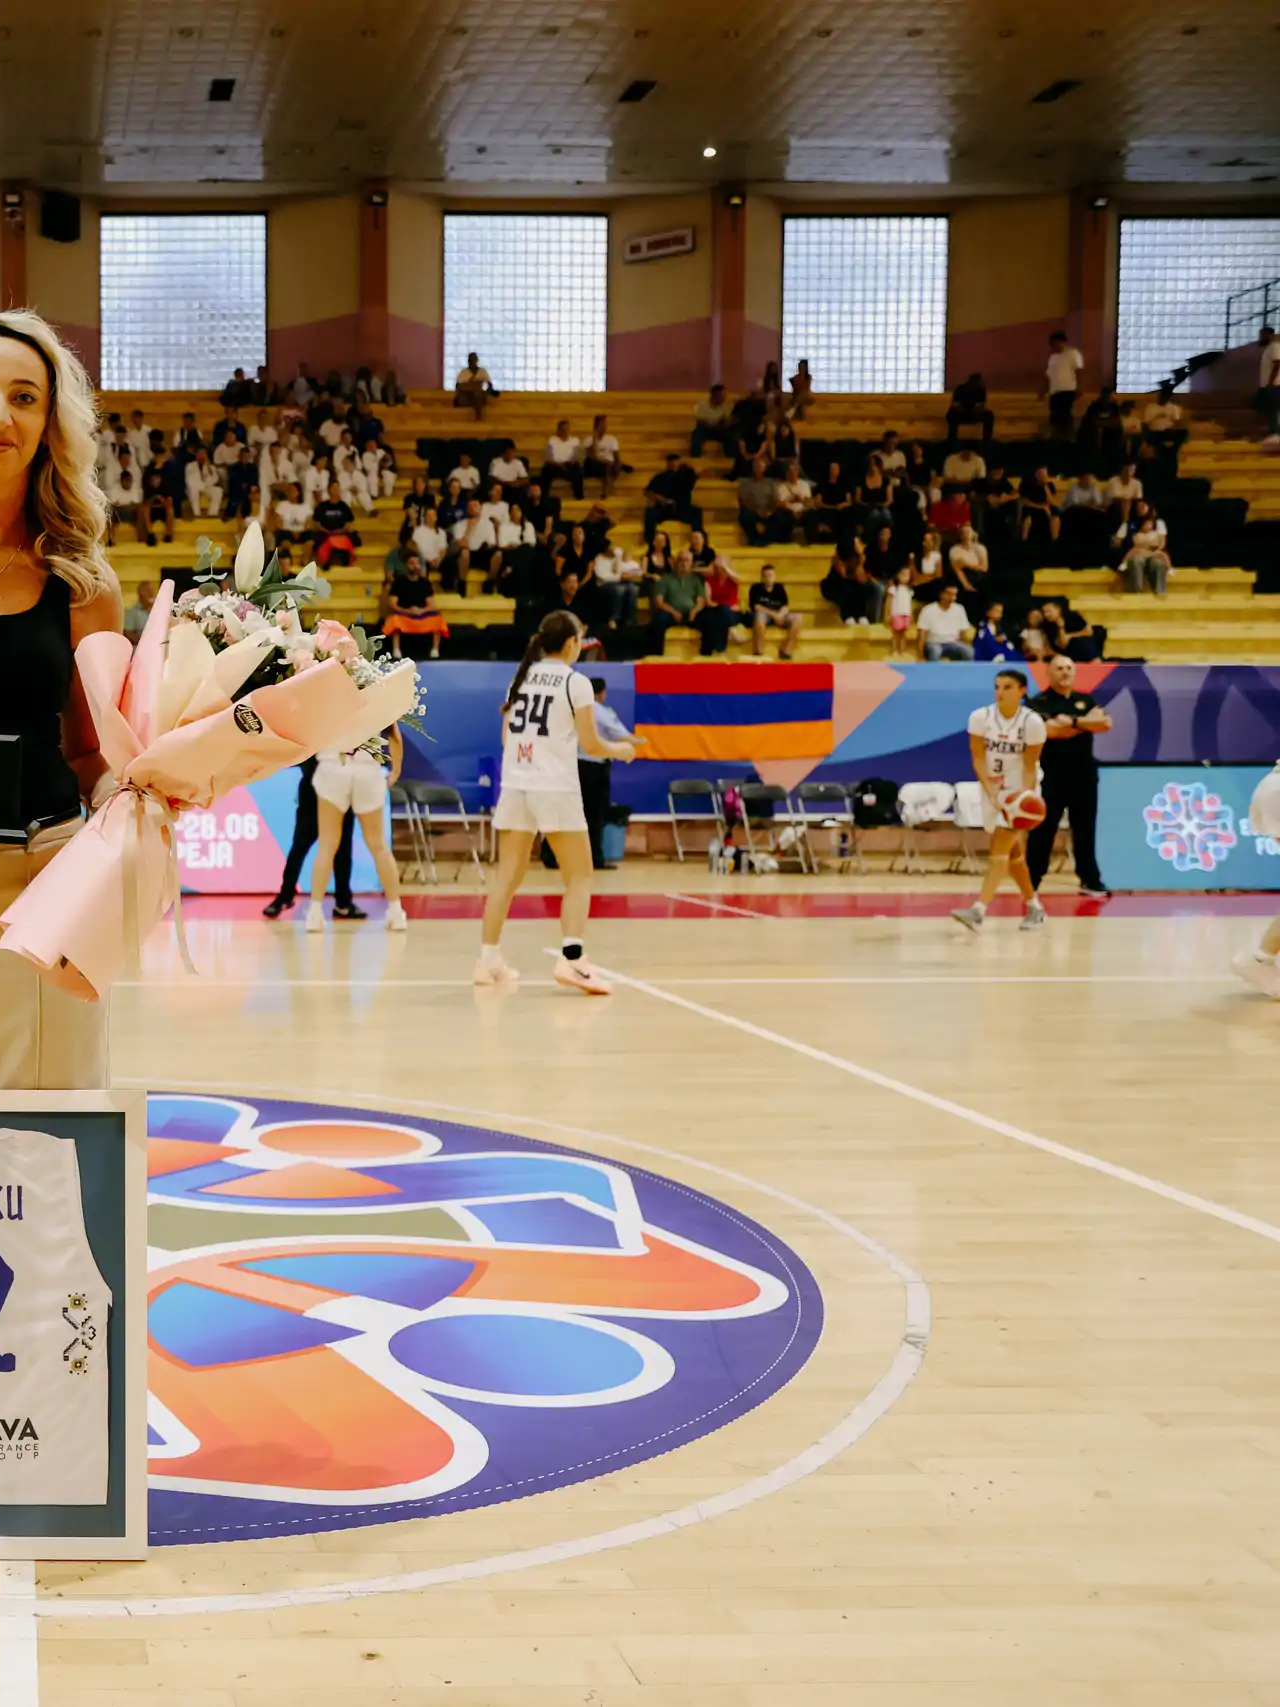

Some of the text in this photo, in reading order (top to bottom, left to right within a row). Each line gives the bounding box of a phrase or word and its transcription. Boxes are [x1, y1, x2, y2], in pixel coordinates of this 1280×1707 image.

[509, 693, 554, 736] 34
[993, 758, 1004, 773] 3
[174, 811, 260, 841] -28.06
[1255, 835, 1280, 856] FO
